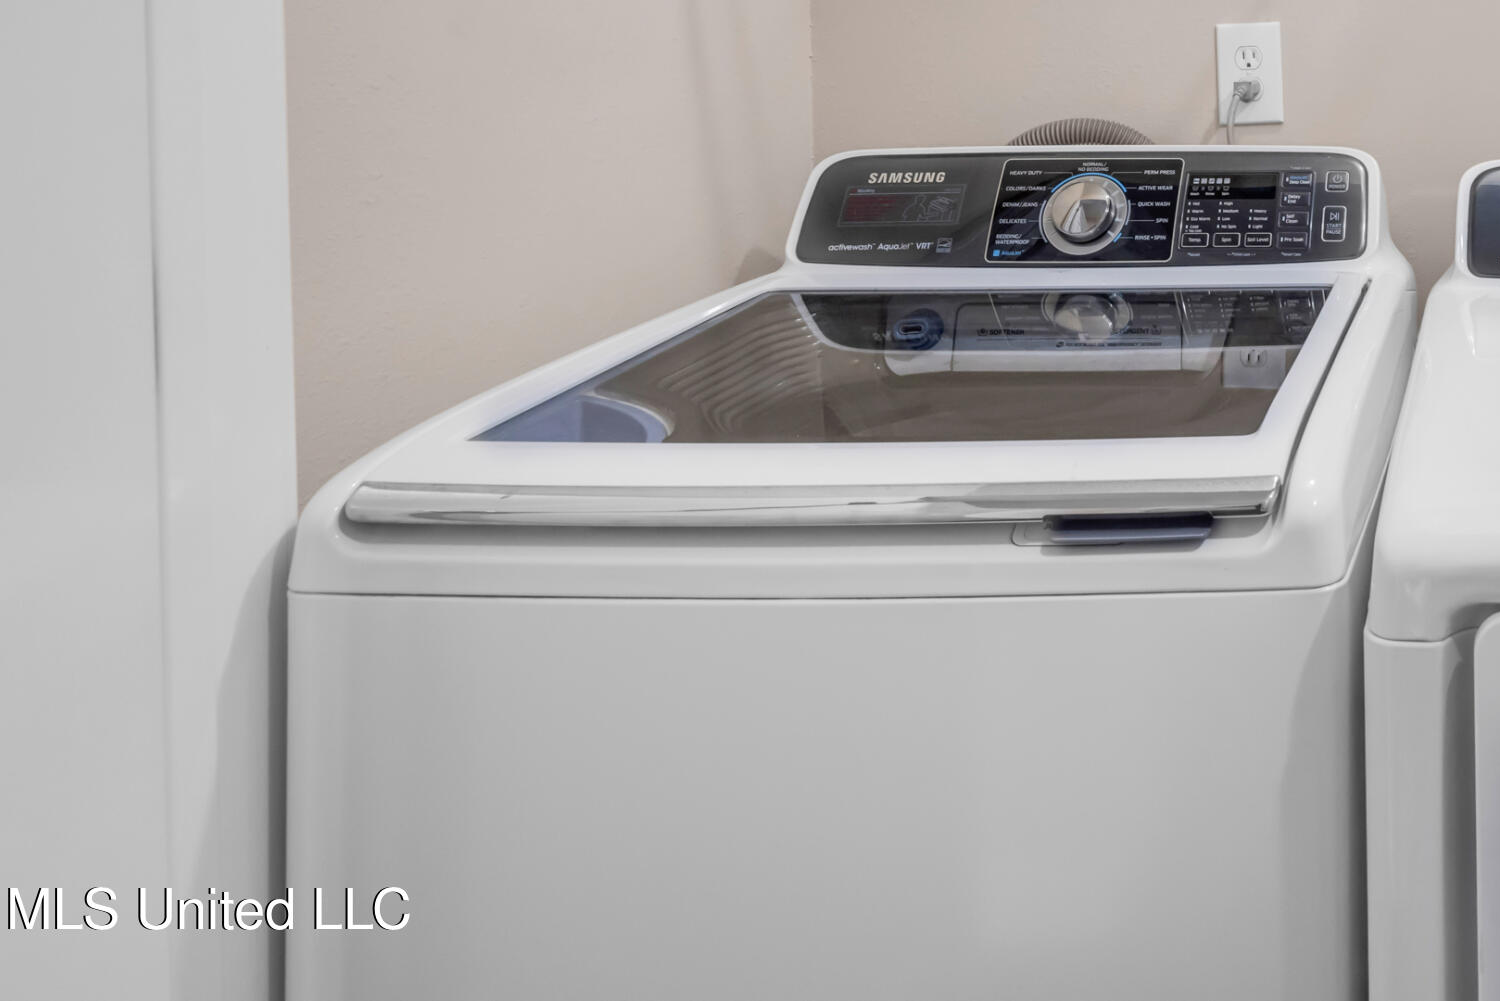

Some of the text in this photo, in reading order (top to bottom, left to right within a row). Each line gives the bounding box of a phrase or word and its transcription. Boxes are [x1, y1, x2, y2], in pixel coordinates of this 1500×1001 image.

[868, 172, 946, 184] SAMSUNG
[828, 242, 932, 252] activewash AquaJet VRT
